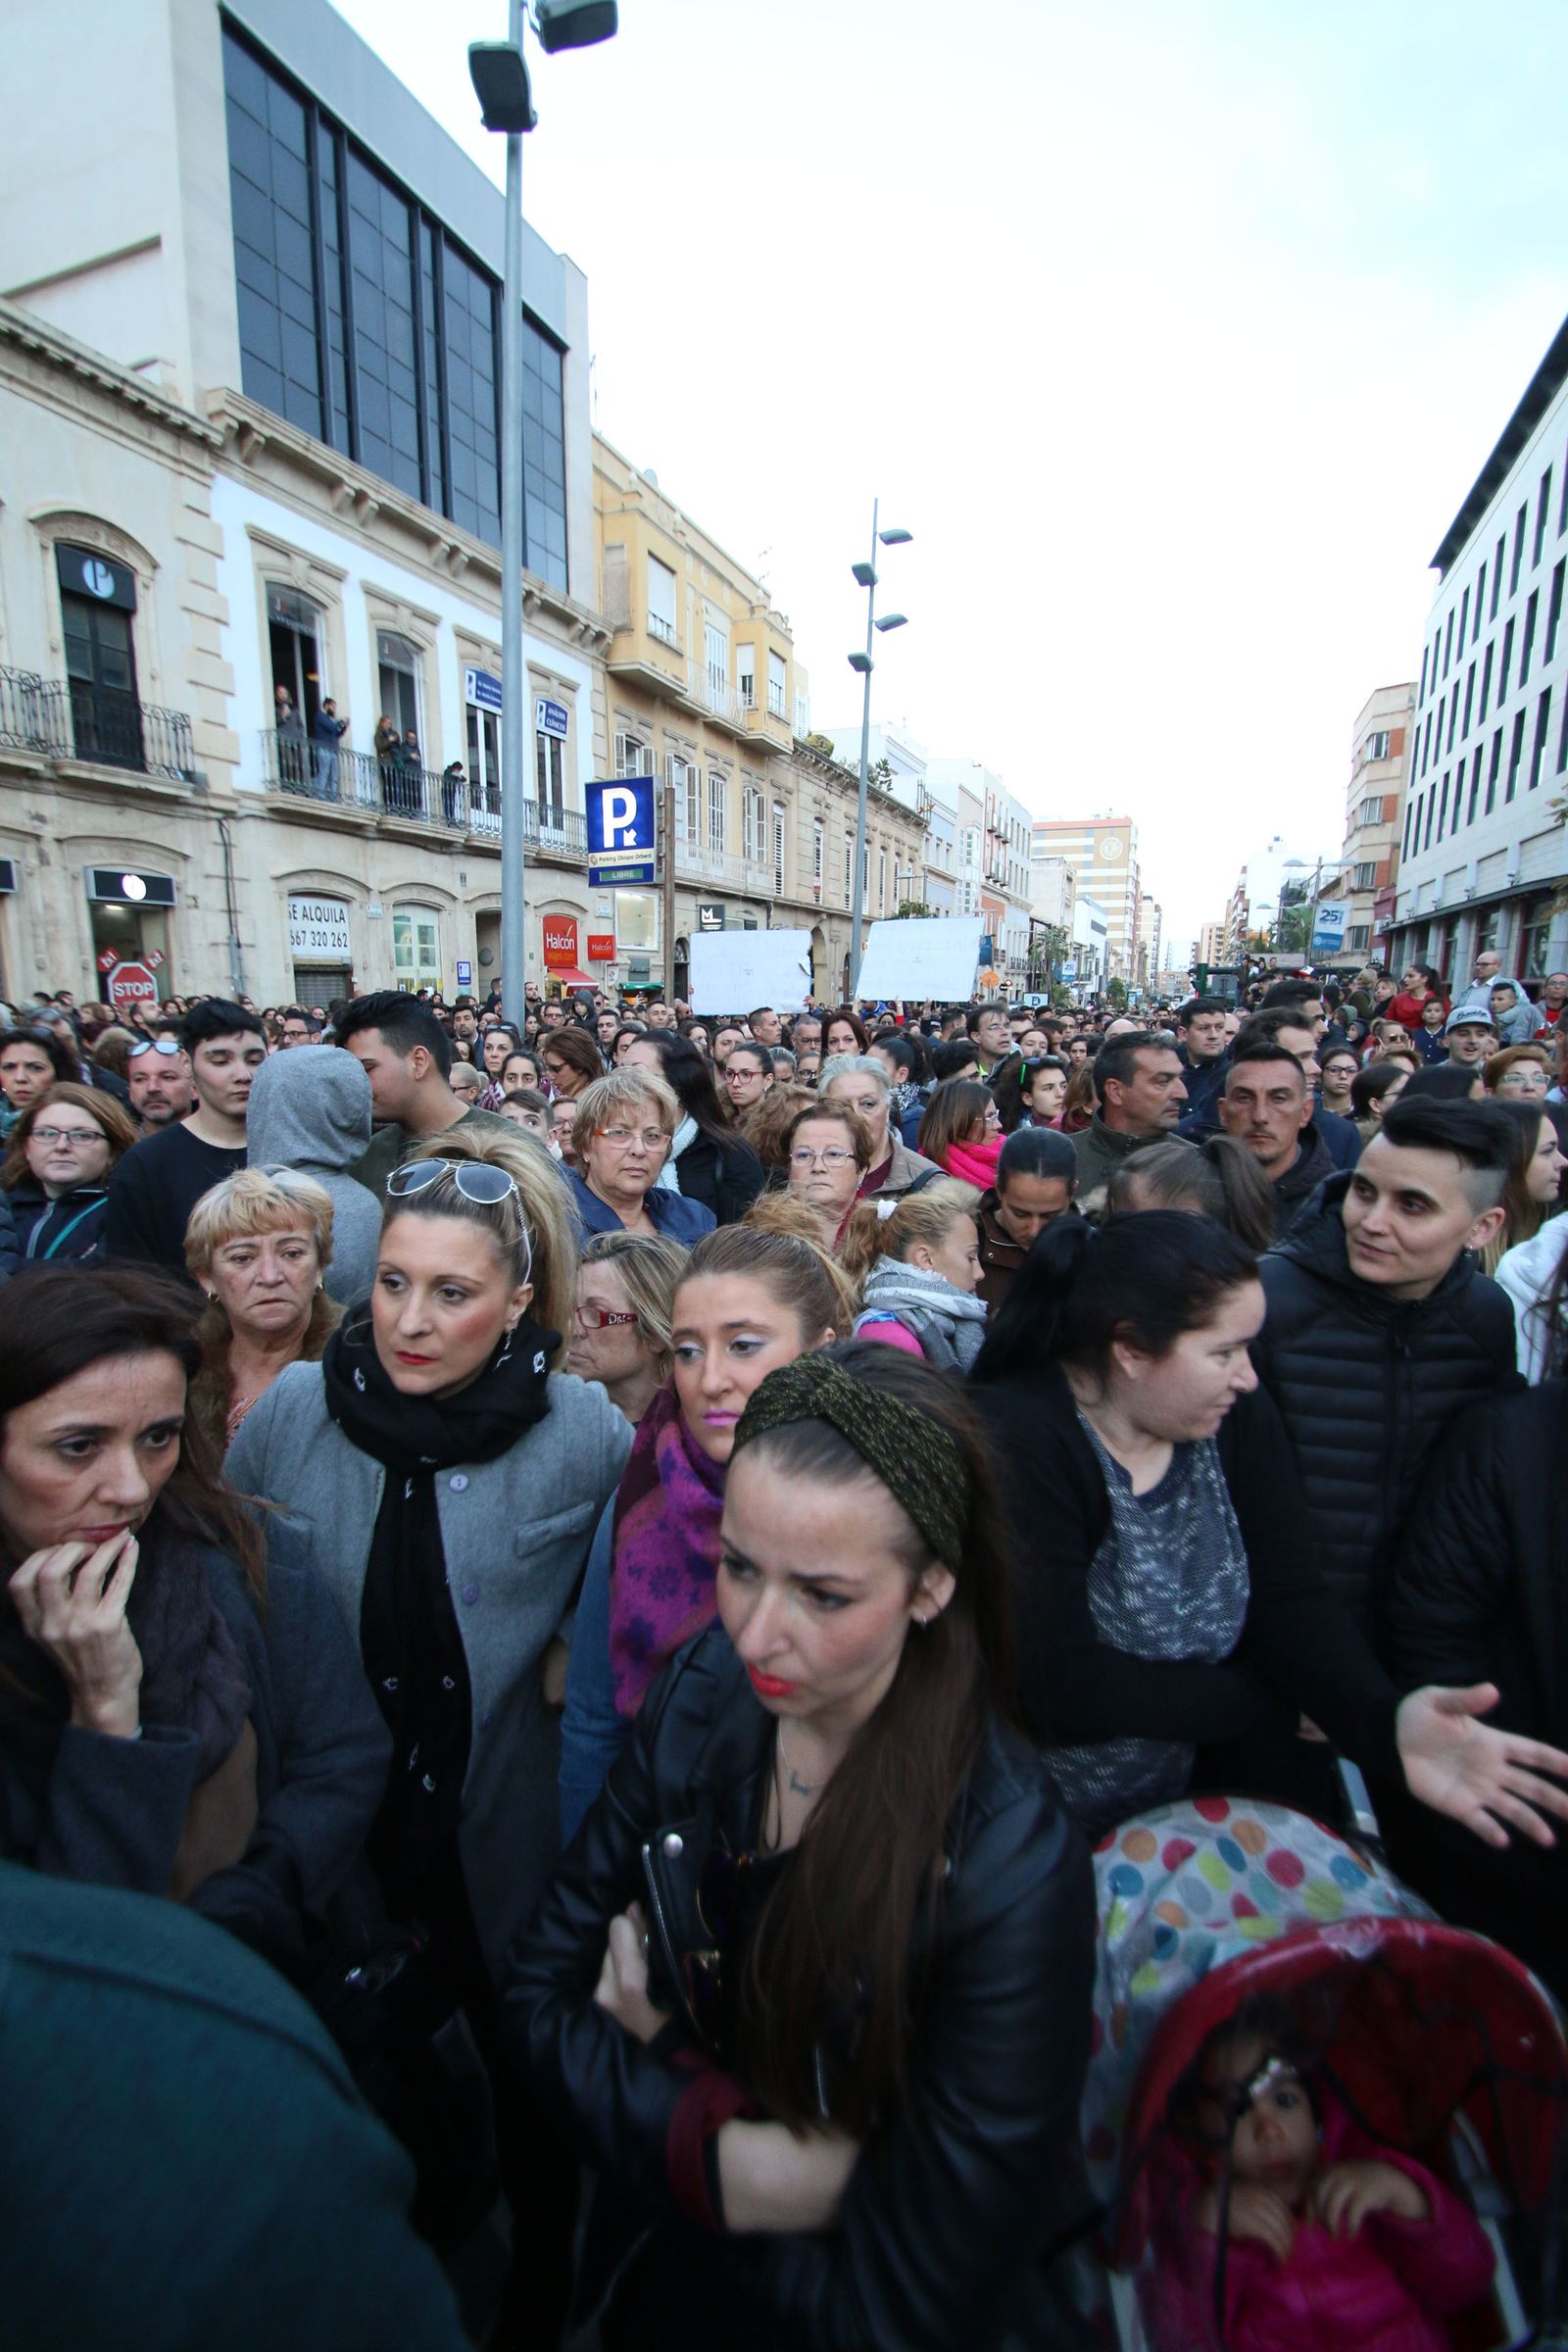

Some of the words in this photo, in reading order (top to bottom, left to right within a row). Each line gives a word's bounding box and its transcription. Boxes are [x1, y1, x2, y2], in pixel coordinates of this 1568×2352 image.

[602, 787, 637, 849] P
[612, 870, 635, 879] LIBRE
[302, 906, 346, 923] ALQUILA
[311, 931, 328, 947] 320
[331, 932, 348, 948] 262
[114, 982, 153, 997] STOP
